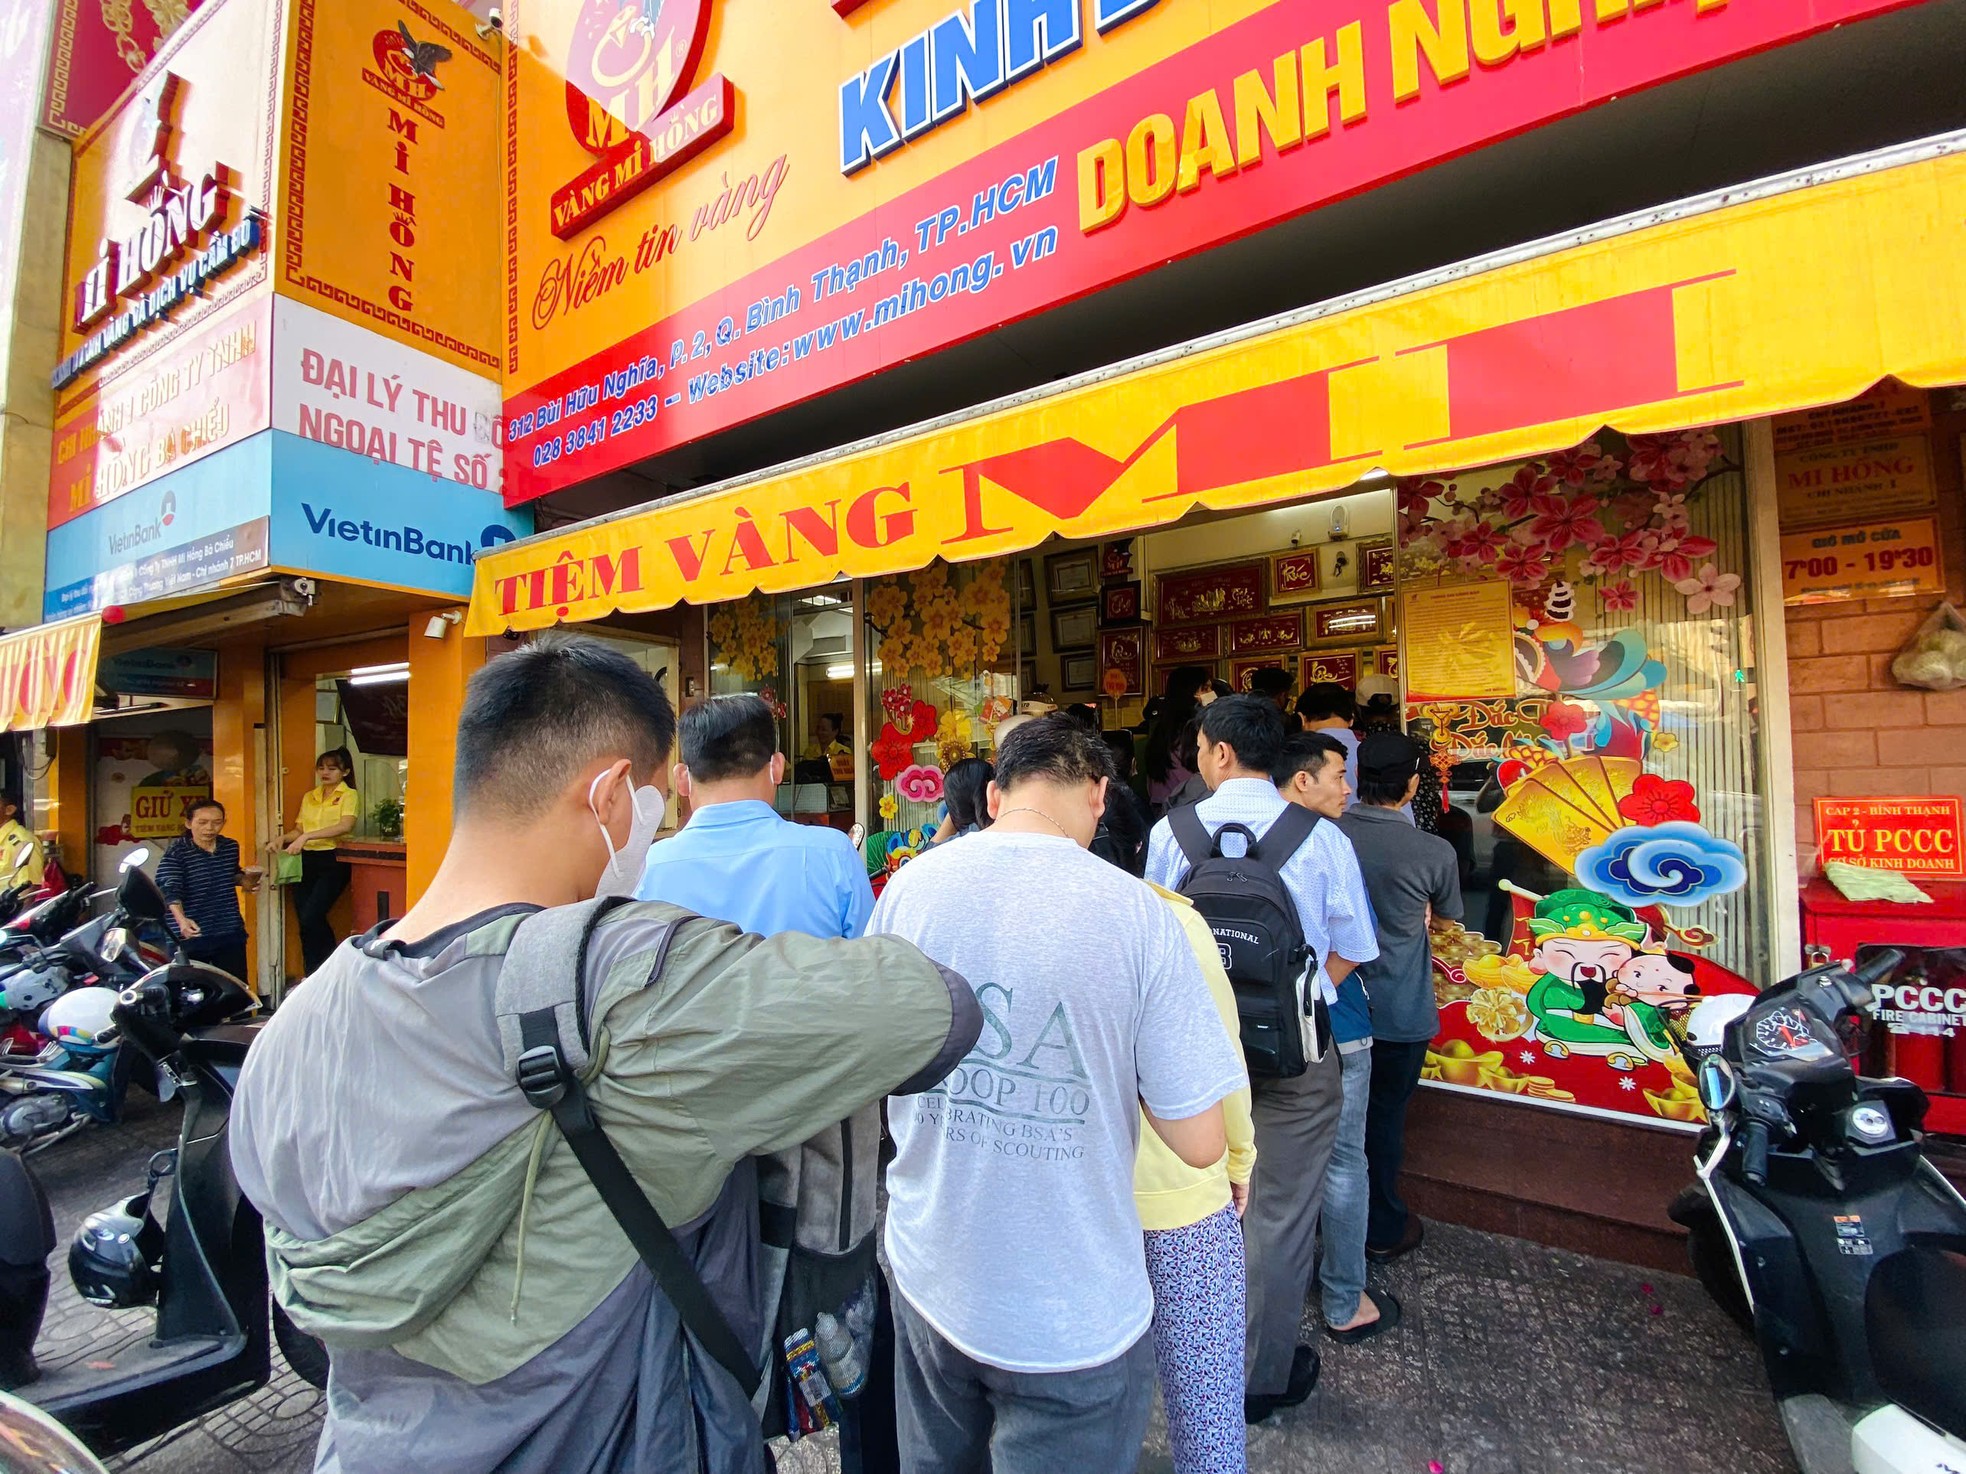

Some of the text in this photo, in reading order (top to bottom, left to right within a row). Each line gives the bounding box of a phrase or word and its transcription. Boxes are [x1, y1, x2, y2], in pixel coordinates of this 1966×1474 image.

[838, 0, 1083, 178] KINH
[1076, 20, 1367, 234] DOANH
[553, 171, 610, 227] VÀNG
[648, 93, 718, 165] HỒNG
[532, 153, 791, 331] Niềm tin vàng
[508, 411, 535, 442] 312
[536, 397, 562, 429] Bùi
[564, 382, 600, 417] Hữu
[602, 355, 667, 402] Nghĩa,
[691, 329, 713, 360] 2,
[715, 315, 742, 347] Q.
[745, 283, 802, 335] Bình
[811, 235, 910, 304] Thạnh,
[914, 154, 1060, 255] TP.HCM
[301, 347, 358, 400] ĐẠI
[367, 371, 404, 414] LÝ
[412, 388, 467, 437] THU
[532, 441, 562, 468] 028
[565, 416, 607, 457] 3841
[610, 394, 659, 437] 2233
[299, 402, 492, 491] NGOẠI TỆ SỐ
[494, 546, 645, 617] TIỆM
[664, 480, 918, 583] VÀNG
[135, 790, 174, 819] GIỮ
[1828, 819, 1954, 853] TỦ PCCC
[1852, 806, 1860, 815] 2
[1869, 804, 1901, 815] BÌNH
[1903, 806, 1950, 817] THẠNH
[1870, 858, 1903, 869] KINH
[1907, 858, 1954, 870] DOANH
[973, 981, 1090, 1079] SA
[1868, 983, 1966, 1014] PCCC
[1872, 1009, 1905, 1021] FIRE
[944, 1067, 1091, 1115] OOP 100
[992, 1139, 1085, 1162] SCOUTING
